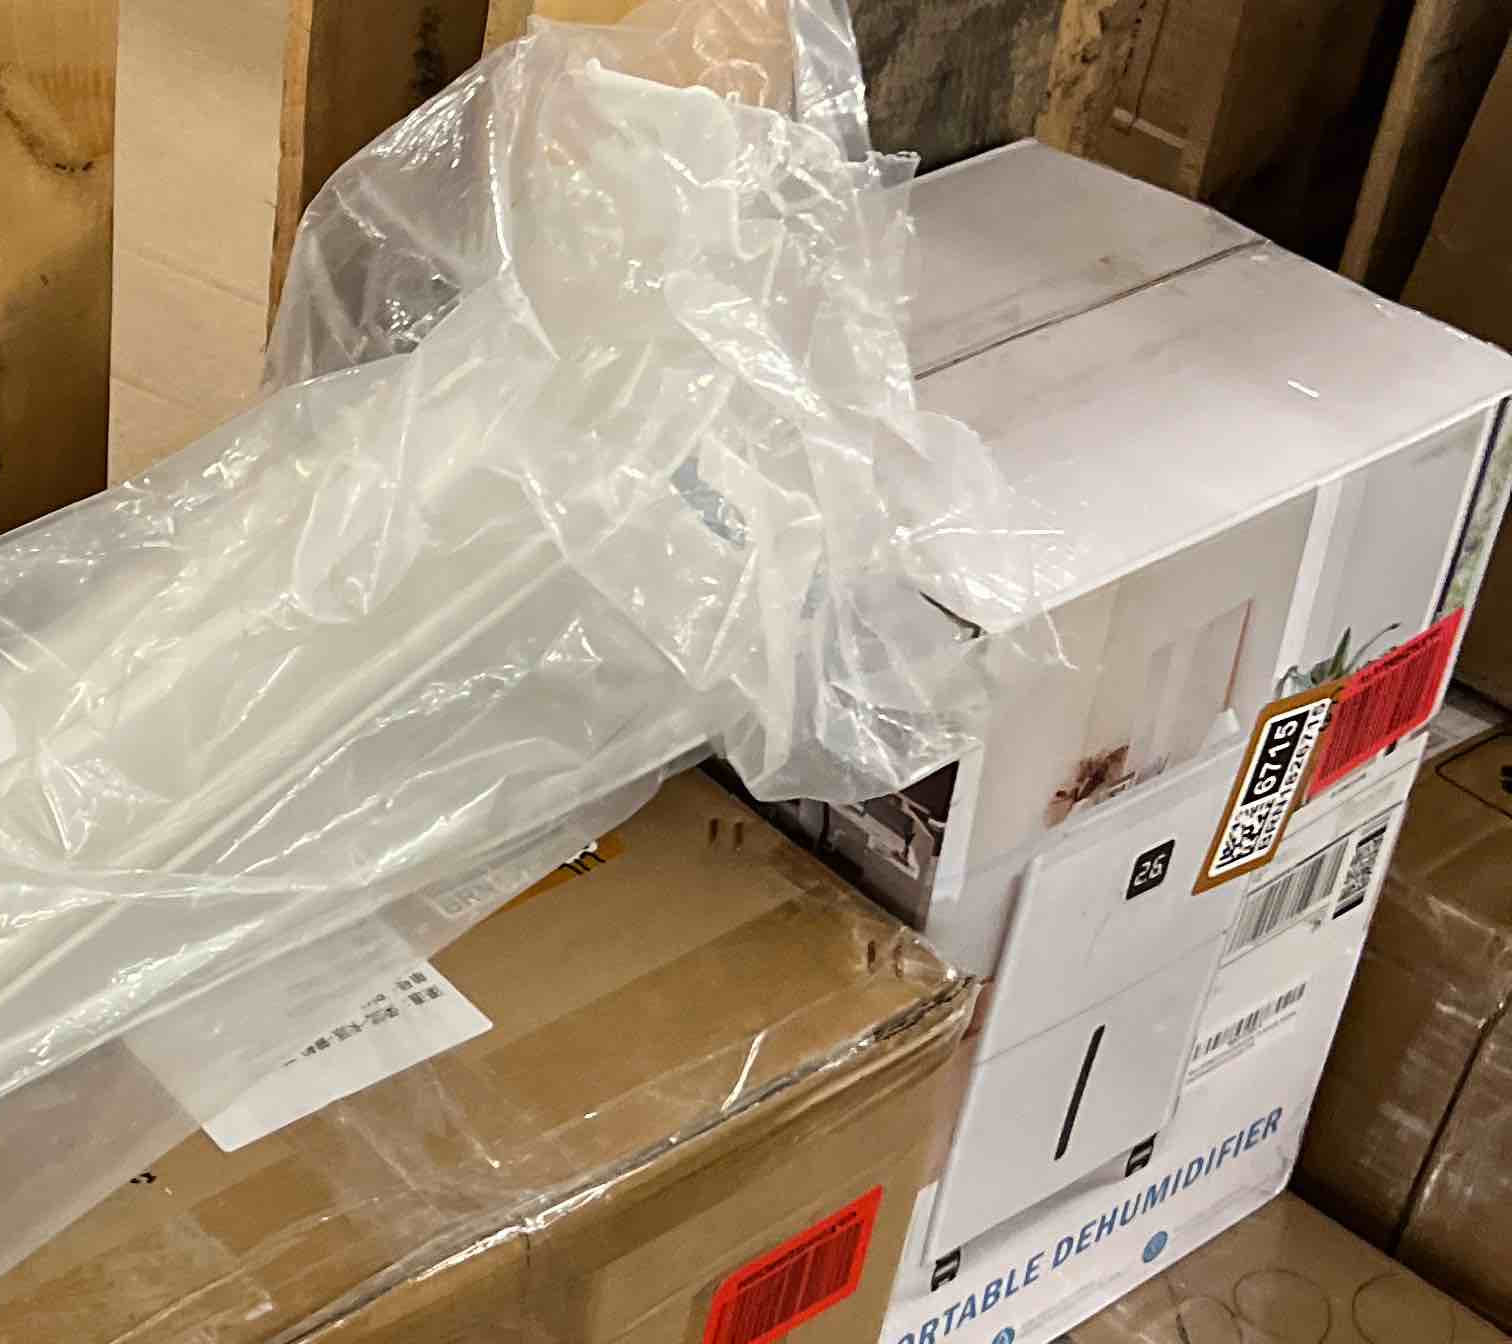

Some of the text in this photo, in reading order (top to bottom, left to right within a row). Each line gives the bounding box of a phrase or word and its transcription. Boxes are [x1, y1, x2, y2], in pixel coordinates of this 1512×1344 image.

[1251, 719, 1300, 796] 6715
[1256, 702, 1328, 852] BRN1826715
[1050, 1106, 1284, 1269] DEHUMIDIFIER
